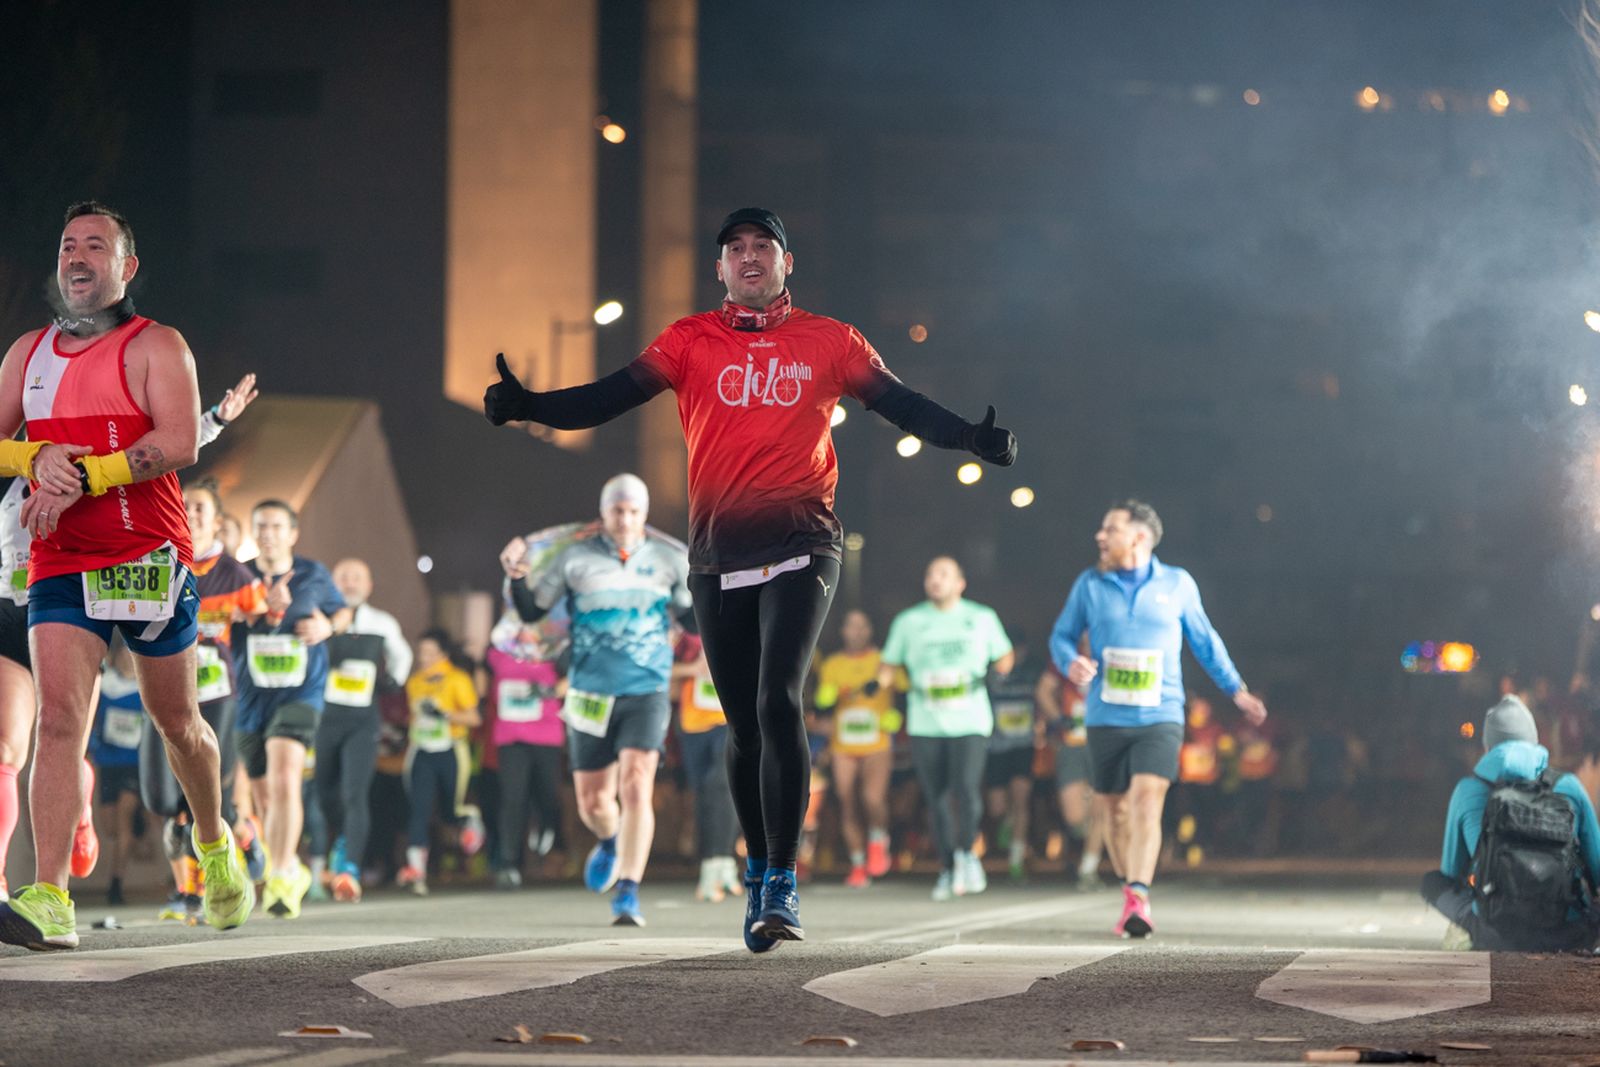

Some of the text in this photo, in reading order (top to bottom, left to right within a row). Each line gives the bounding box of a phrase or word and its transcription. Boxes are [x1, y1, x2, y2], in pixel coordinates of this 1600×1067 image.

[779, 361, 812, 381] cubin
[108, 420, 118, 449] CLUB
[100, 566, 159, 591] 9338
